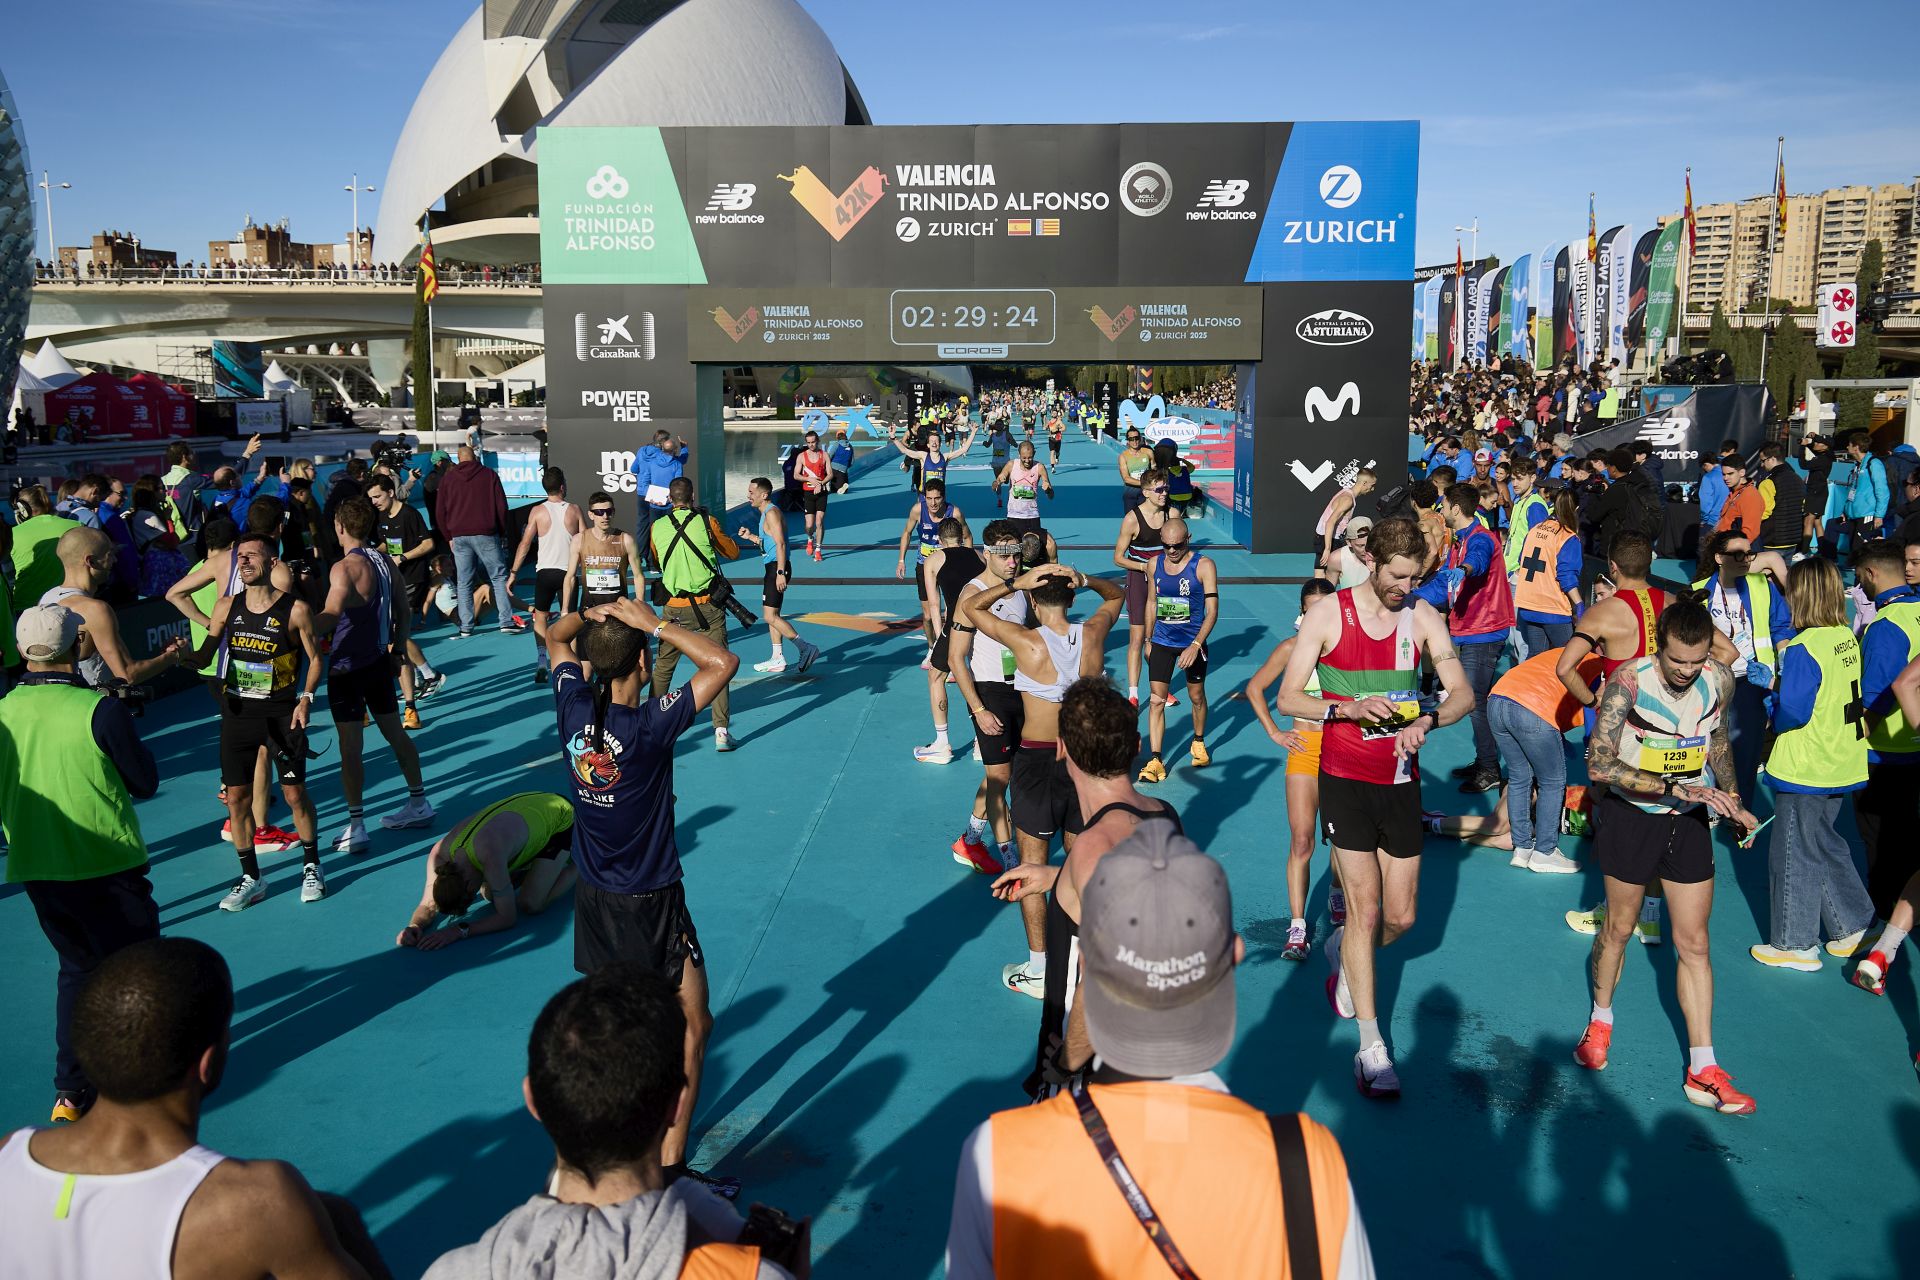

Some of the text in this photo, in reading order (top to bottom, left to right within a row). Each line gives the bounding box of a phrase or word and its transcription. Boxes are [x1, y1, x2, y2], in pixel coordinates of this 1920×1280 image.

[896, 164, 996, 187] VALENCIA
[565, 203, 654, 214] FUNDACIÓN
[835, 181, 874, 228] 42K
[897, 191, 1110, 212] TRINIDAD ALFONSO
[695, 213, 765, 224] new balance
[1186, 209, 1257, 221] new balance
[564, 217, 655, 234] TRINIDAD
[928, 221, 995, 237] ZURICH
[1283, 220, 1397, 244] ZURICH
[565, 235, 656, 251] ALFONSO
[1468, 277, 1478, 308] new
[763, 305, 810, 317] VALENCIA
[1140, 304, 1188, 316] VALENCIA
[764, 319, 863, 329] TRINIDAD ALFONSO
[1140, 317, 1242, 328] TRINIDAD ALFONSO
[1302, 322, 1368, 337] ASTURIANA
[779, 333, 810, 341] ZURICH
[813, 332, 830, 341] 2025
[1155, 331, 1187, 340] ZURICH
[1190, 331, 1208, 340] 2025
[590, 347, 641, 359] CaixaBank
[943, 347, 1003, 355] COROS
[581, 390, 650, 407] POWER
[613, 406, 650, 422] ADE
[1652, 448, 1699, 460] alance
[1333, 459, 1361, 482] VALENCIA
[1338, 466, 1360, 488] CIUDAD
[1536, 532, 1549, 541] TEAM
[231, 636, 278, 653] ARUNCI
[1833, 638, 1858, 656] MEDICA
[1841, 654, 1858, 669] TEAM
[1663, 750, 1688, 761] 1239
[1663, 763, 1686, 772] Kevin
[1115, 944, 1207, 975] Marathon
[1146, 965, 1207, 992] Sports
